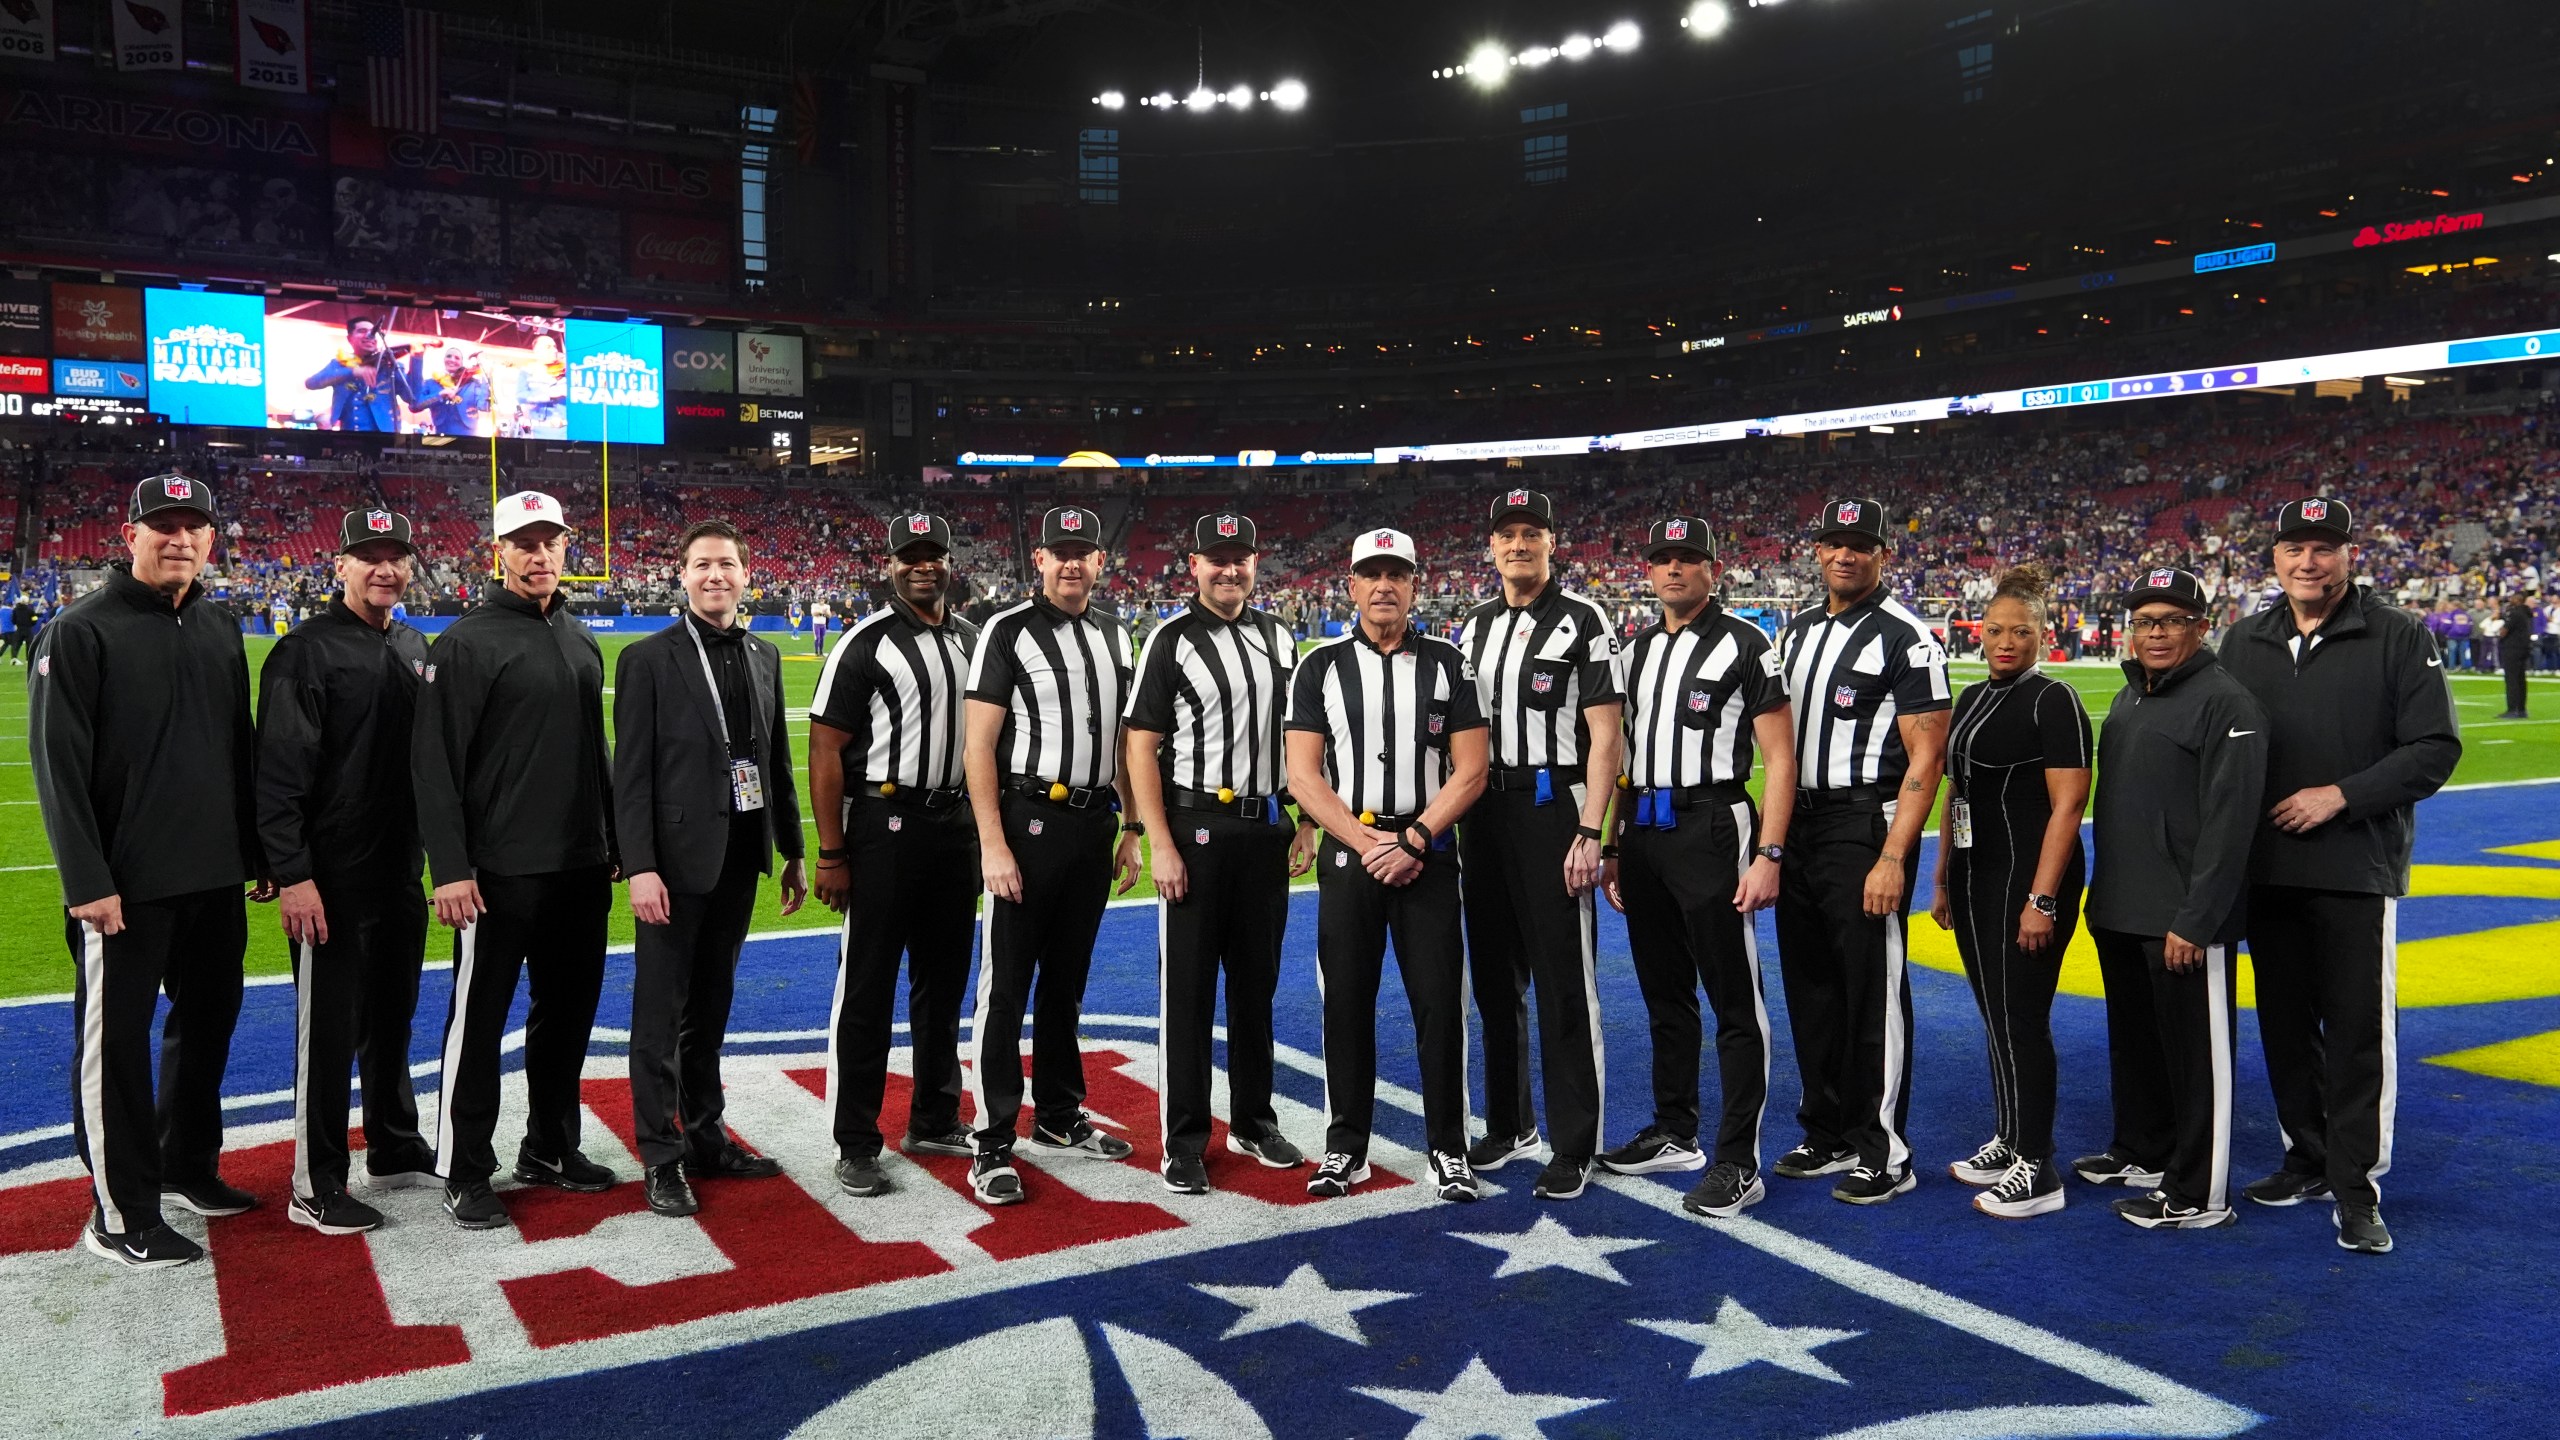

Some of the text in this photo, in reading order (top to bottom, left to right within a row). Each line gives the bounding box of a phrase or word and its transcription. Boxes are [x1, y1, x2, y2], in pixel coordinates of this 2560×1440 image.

[125, 51, 173, 65] 2009
[248, 67, 298, 85] 2015
[8, 90, 318, 157] ARIZONA
[387, 134, 711, 199] CARDINALS
[2382, 212, 2483, 243] State Farm
[2197, 246, 2271, 269] BUD LIGHT
[323, 278, 387, 290] CARDINALS
[476, 290, 502, 300] RING
[519, 294, 556, 303] HONOR
[1843, 308, 1889, 328] SAFEWAY
[56, 328, 137, 343] Dignity Health
[1691, 337, 1724, 350] BETMGM
[154, 344, 260, 369] MARIACHI
[673, 350, 726, 371] COX
[2201, 372, 2215, 388] 0
[2524, 336, 2541, 355] 0
[70, 368, 100, 378] BUD
[154, 363, 262, 387] RAMS
[749, 365, 791, 377] University
[65, 377, 105, 388] LIGHT
[570, 370, 658, 391] MARIACHI
[749, 376, 792, 386] of Phoenix
[570, 387, 659, 408] RAMS
[676, 404, 725, 418] verizon
[759, 409, 803, 420] BETMGM
[1804, 418, 1817, 427] The
[773, 432, 791, 447] 25
[1643, 427, 1721, 443] PORSCHE
[1316, 452, 1373, 461] TOGETHER
[1456, 447, 1468, 455] The
[977, 454, 1035, 463] TOGETHER
[1160, 454, 1216, 463] TOGETHER
[168, 485, 189, 496] NFL
[524, 500, 543, 510] NFL
[1510, 496, 1527, 505] NFL
[1839, 511, 1857, 521] NFL
[2305, 507, 2324, 518] NFL
[371, 519, 390, 529] NFL
[912, 521, 929, 532] NFL
[1064, 519, 1080, 528] NFL
[1220, 524, 1236, 535] NFL
[1667, 528, 1685, 538] NFL
[1377, 538, 1393, 548] NFL
[2151, 576, 2170, 586] NFL
[1535, 680, 1550, 691] NFL
[1690, 699, 1707, 709] NFL
[1836, 694, 1853, 706] NFL
[734, 786, 742, 811] STAFF
